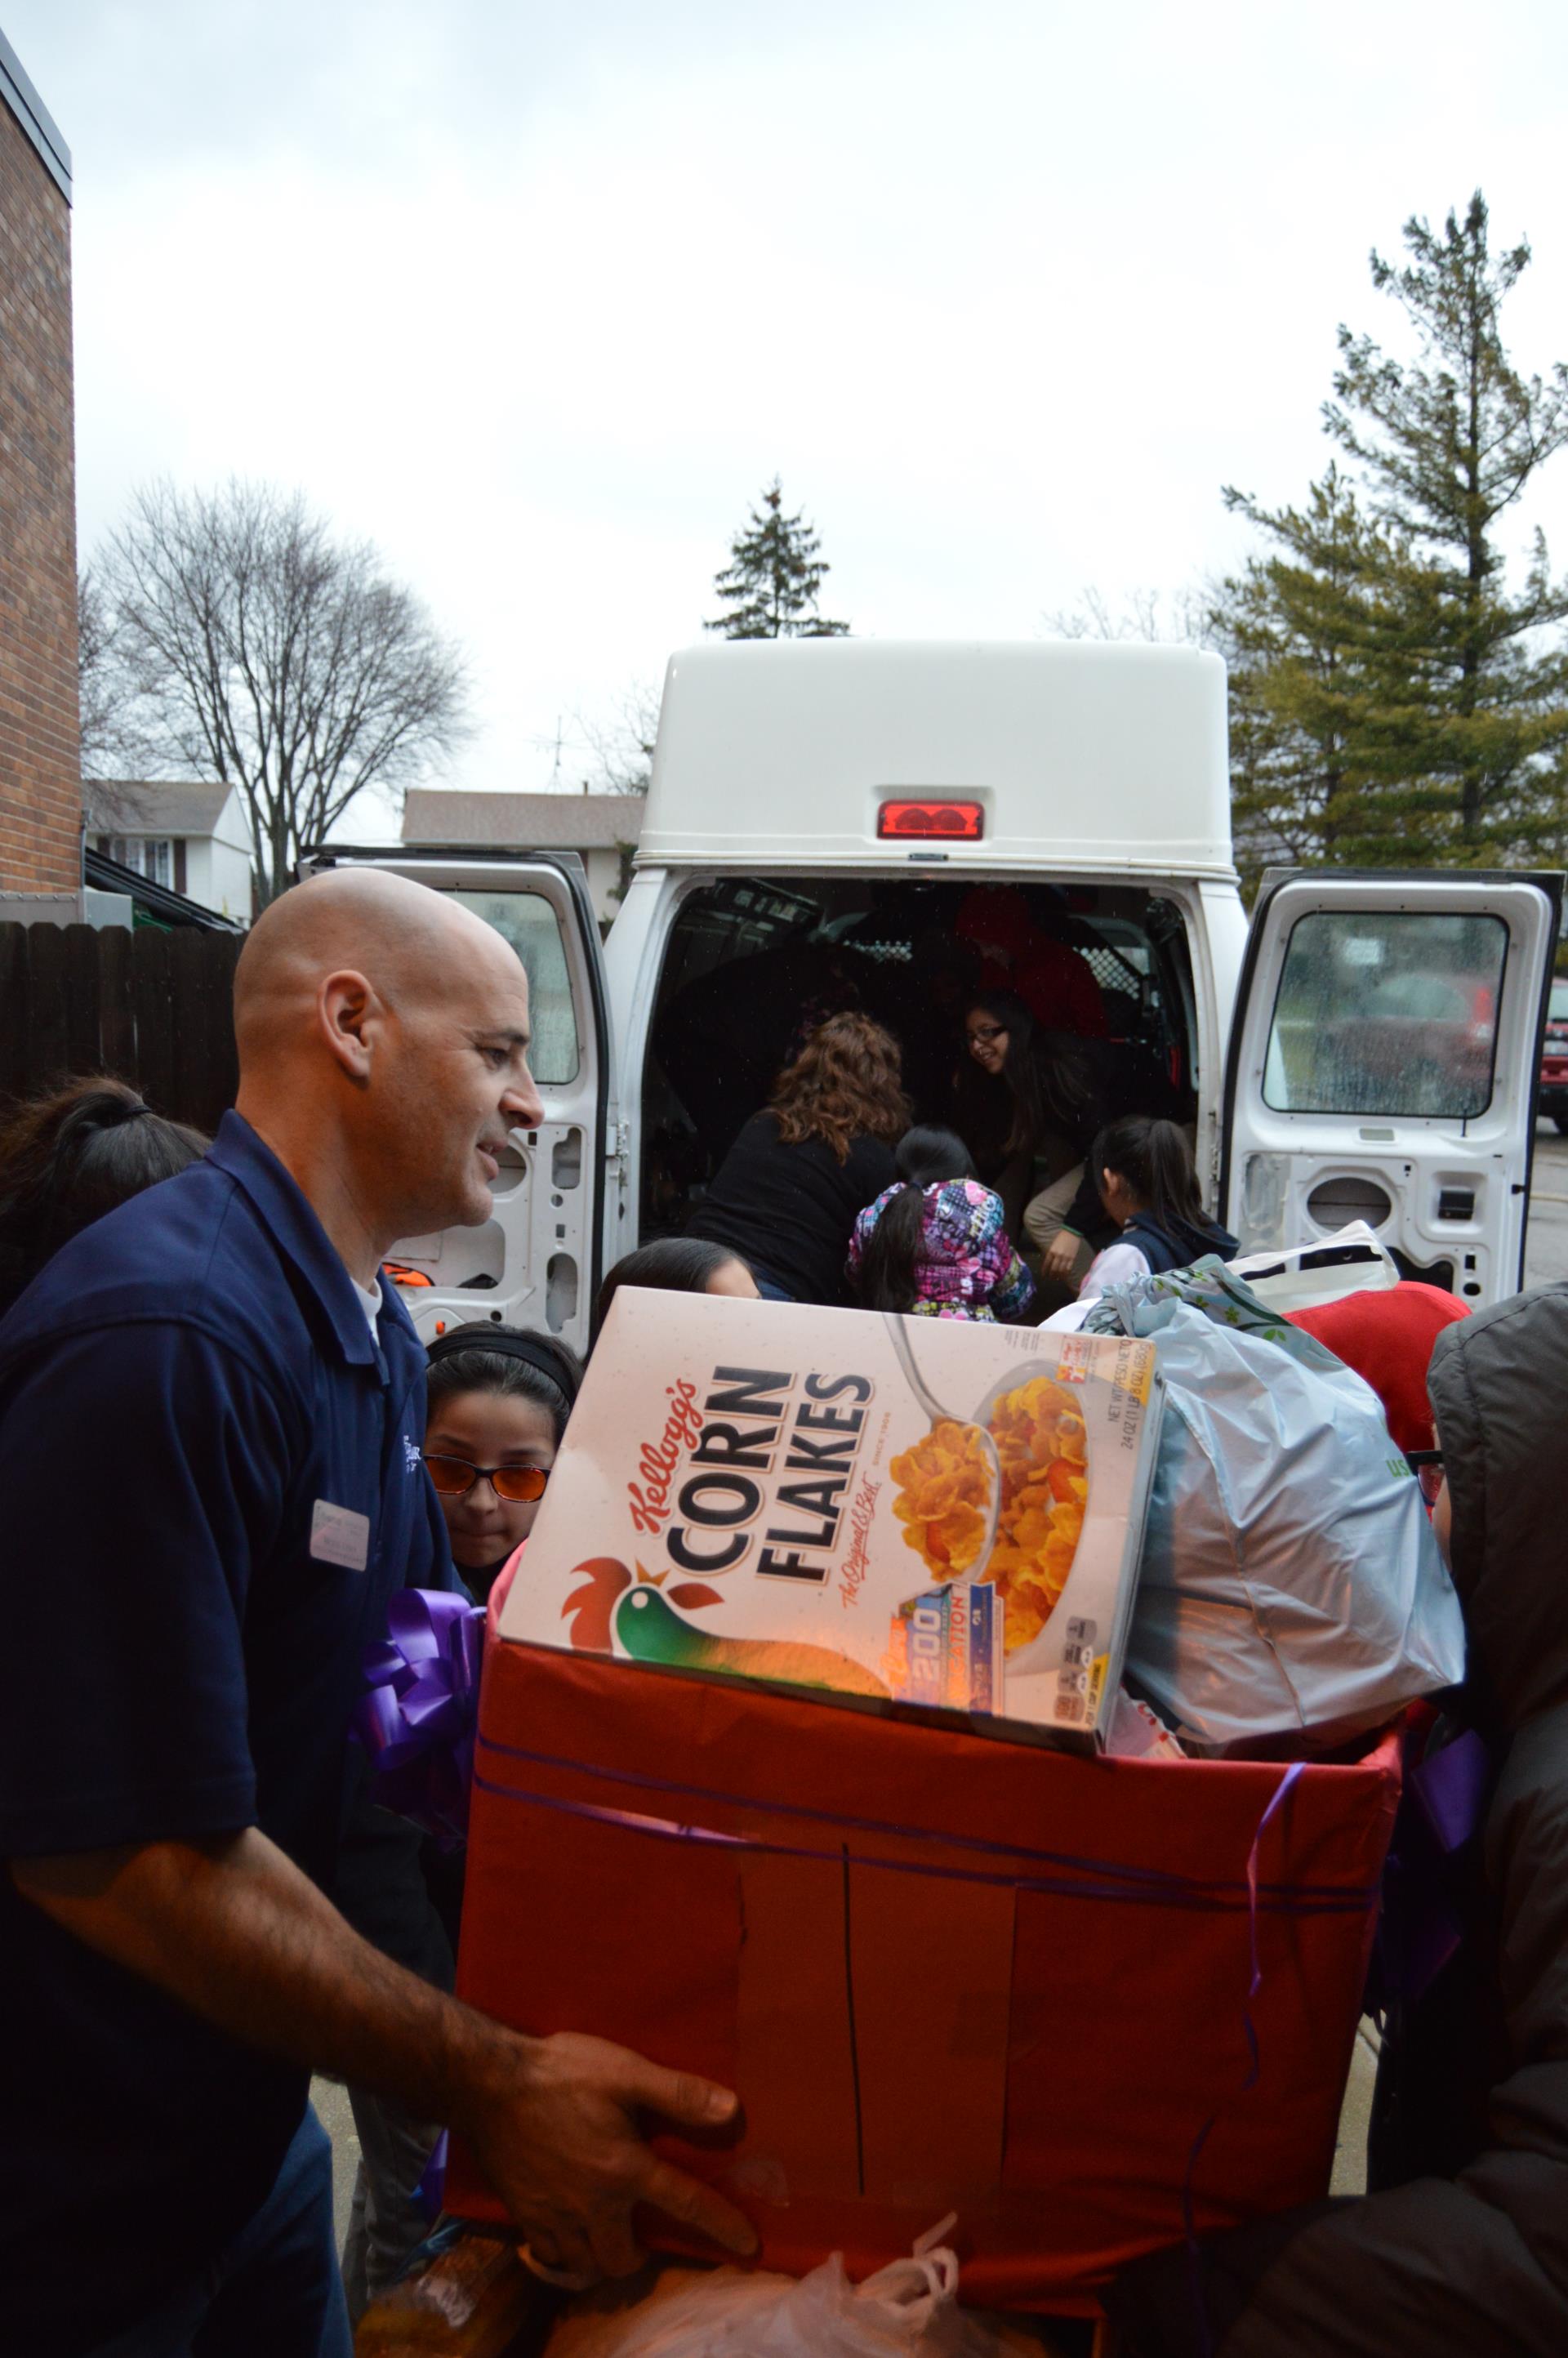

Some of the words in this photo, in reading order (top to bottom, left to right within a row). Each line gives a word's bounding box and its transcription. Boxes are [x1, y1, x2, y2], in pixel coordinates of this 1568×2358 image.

[628, 1379, 702, 1534] Kellogg's
[873, 1439, 886, 1466] SINCE
[1121, 1436, 1134, 1450] 24
[1123, 1421, 1136, 1435] OZ
[667, 1366, 792, 1571] CORN
[755, 1373, 871, 1581] FLAKES
[841, 1518, 870, 1583] Original
